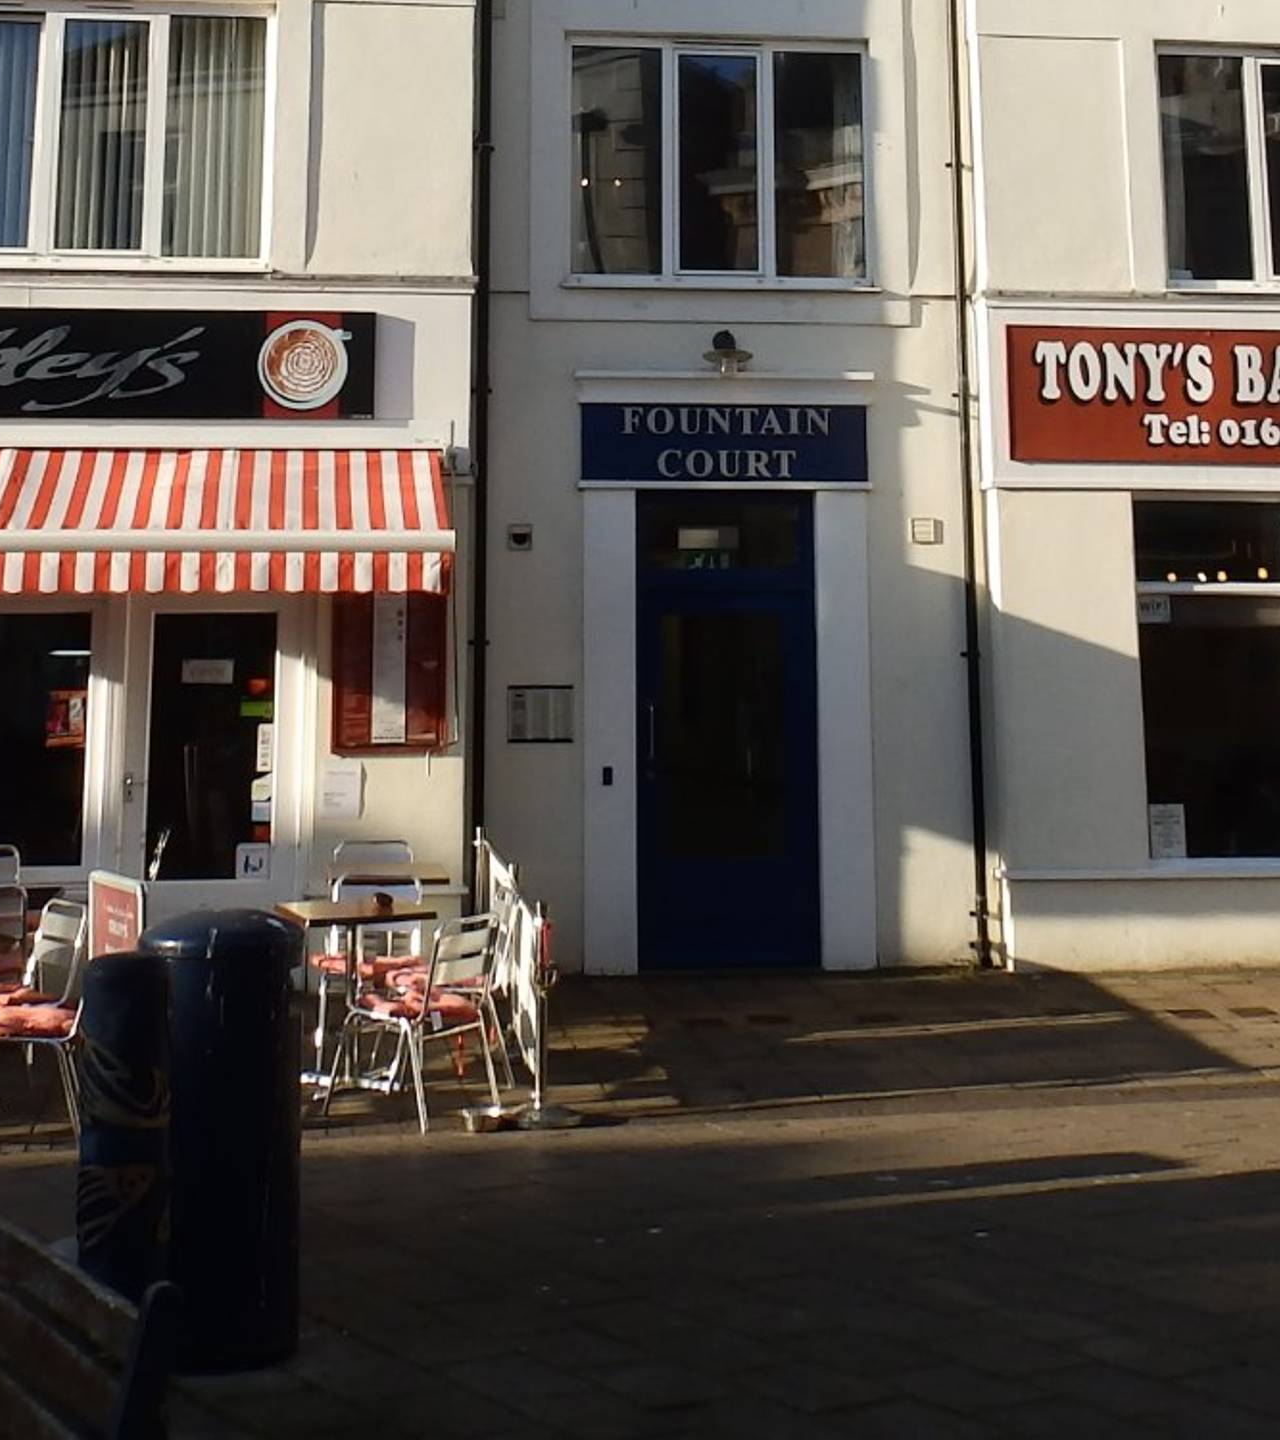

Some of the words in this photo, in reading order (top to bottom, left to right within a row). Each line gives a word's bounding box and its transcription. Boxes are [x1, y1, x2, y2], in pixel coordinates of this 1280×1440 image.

[1035, 341, 1215, 404] TONY'S
[621, 406, 832, 437] FOUNTAIN
[1143, 413, 1210, 447] Tel:
[656, 448, 797, 479] COURT
